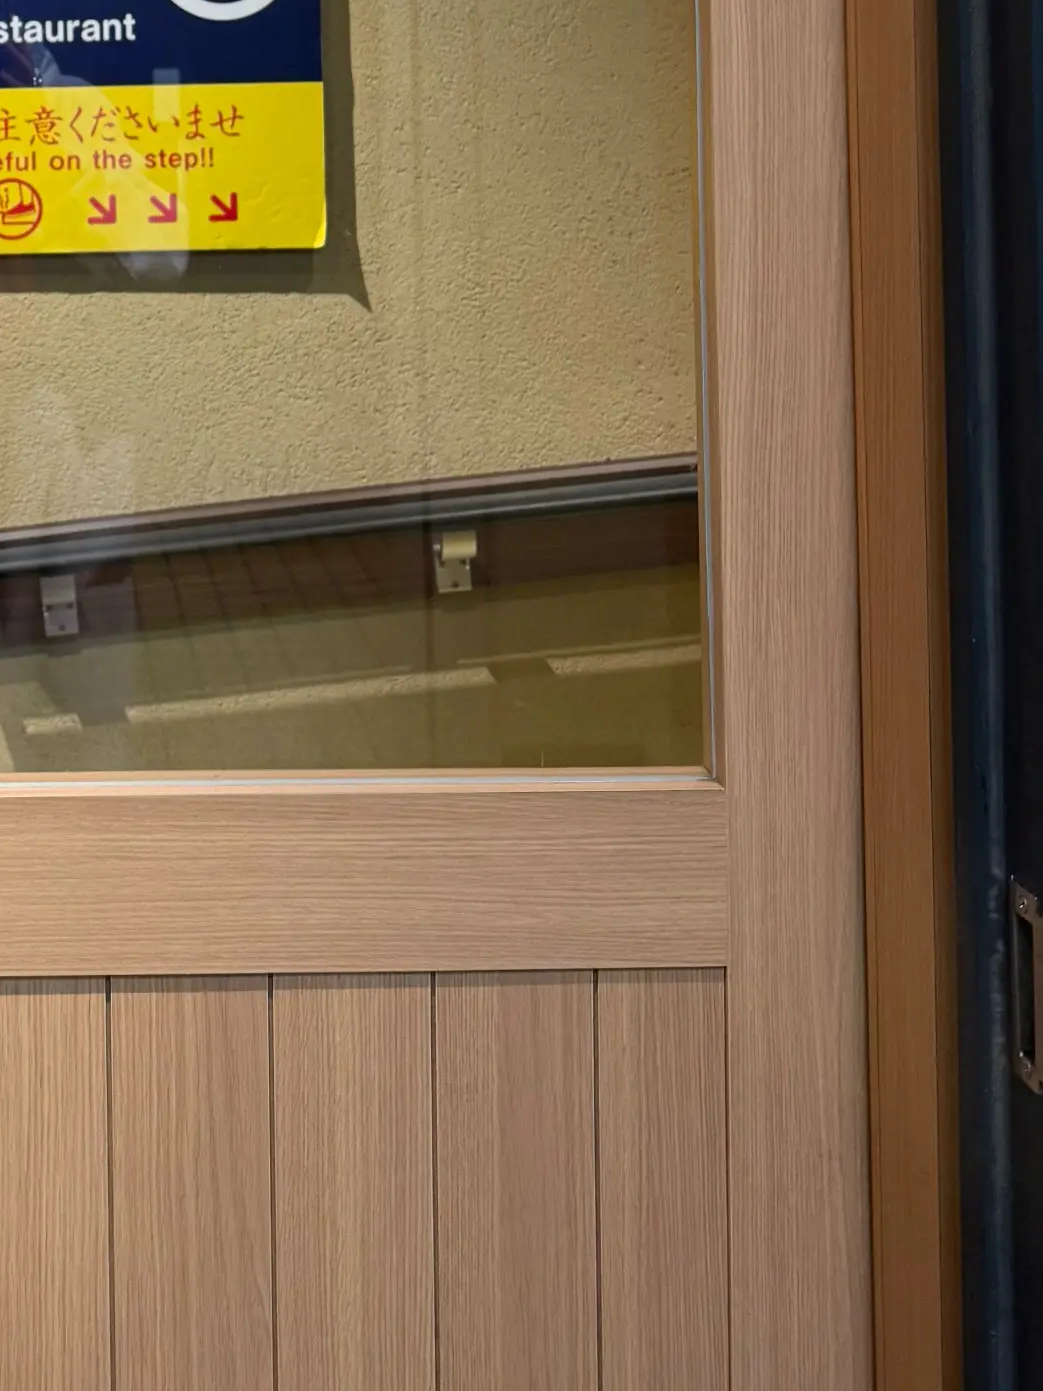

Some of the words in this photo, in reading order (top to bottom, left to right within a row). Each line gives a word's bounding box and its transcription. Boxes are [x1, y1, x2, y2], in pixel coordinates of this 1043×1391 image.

[49, 153, 82, 171] on
[92, 150, 133, 170] the
[144, 148, 216, 172] step!!
